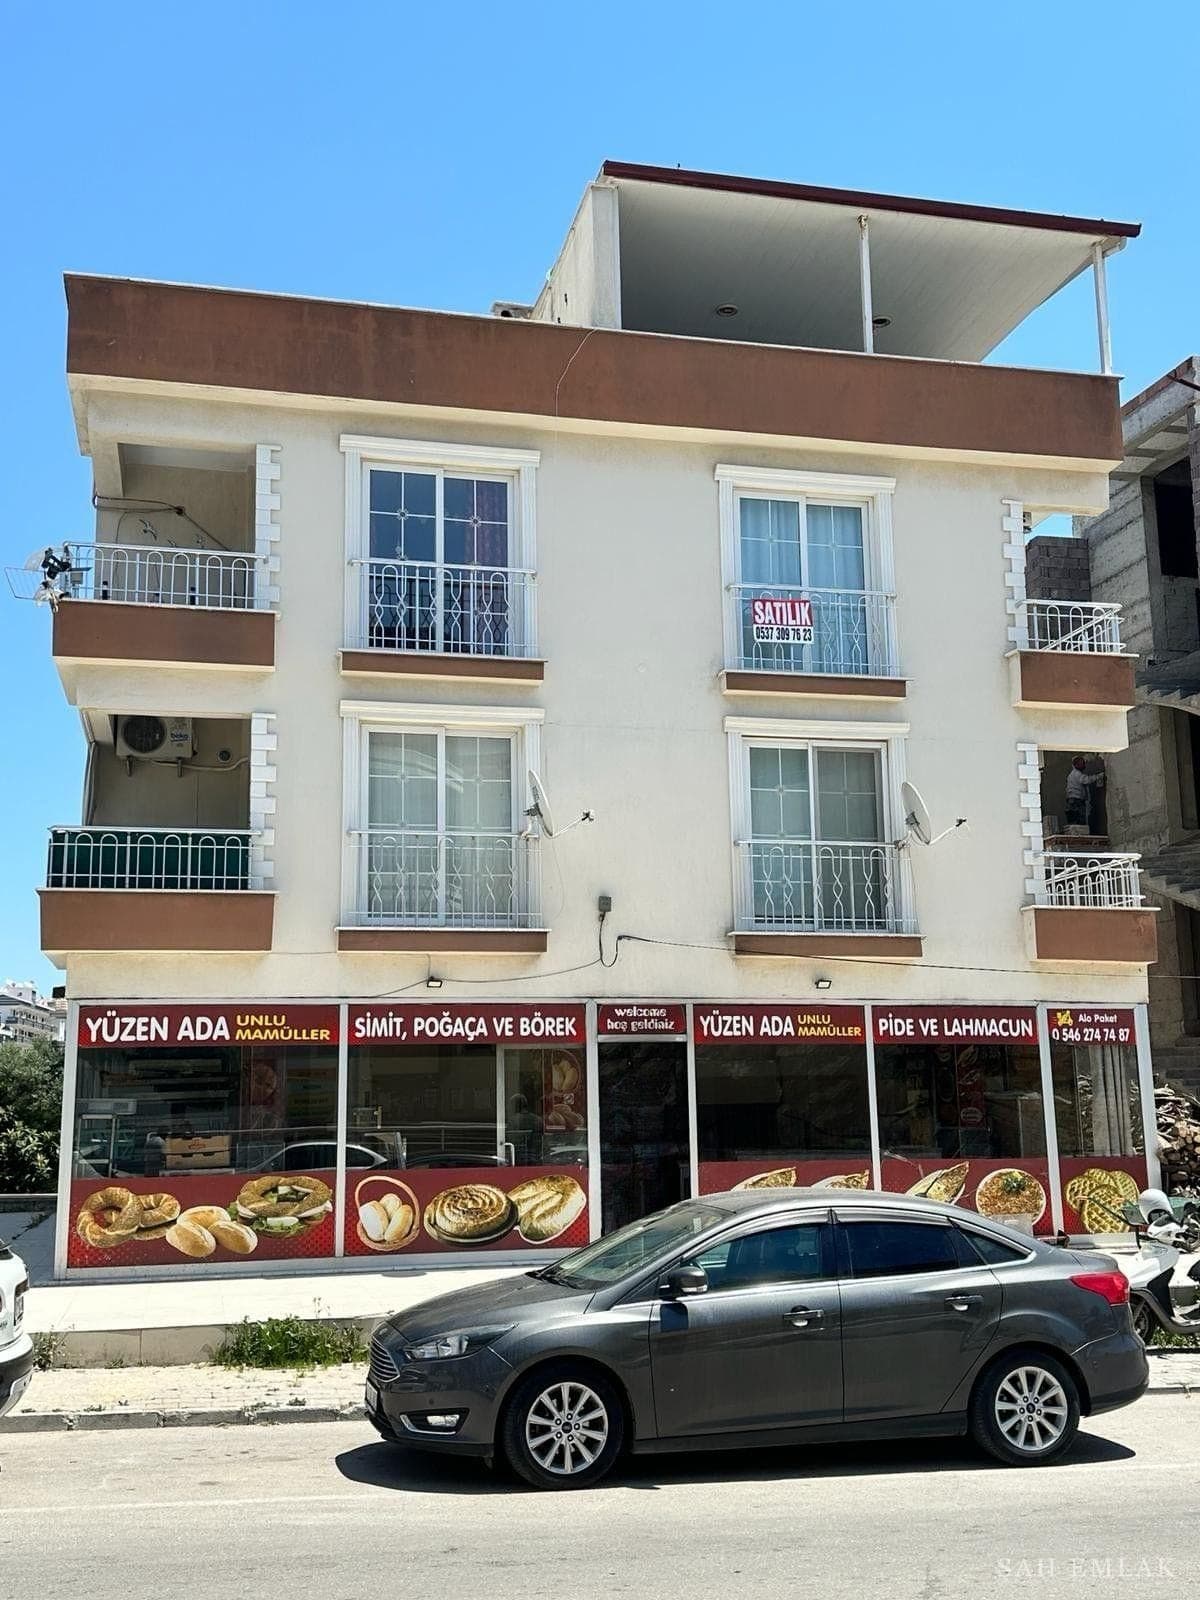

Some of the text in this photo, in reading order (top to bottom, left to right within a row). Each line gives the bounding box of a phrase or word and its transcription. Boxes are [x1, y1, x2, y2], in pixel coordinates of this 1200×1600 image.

[754, 600, 811, 626] SATILIK
[756, 626, 812, 642] 0537 309 76 23
[614, 1006, 667, 1017] welcome
[1078, 1013, 1117, 1024] Alo Paket
[86, 1010, 230, 1043] YÜZEN ADA
[236, 1015, 286, 1026] UNLU
[355, 1011, 577, 1041] SİMİT, POĞAÇA VE BÖREK
[607, 1018, 675, 1032] hoş geldiniz
[700, 1010, 795, 1037] YÜZEN ADA
[798, 1015, 831, 1025] UNLU
[878, 1012, 1033, 1037] PİDE VE LAHMACUN
[235, 1026, 330, 1041] MAMÜLLER
[797, 1025, 862, 1037] MAMÜLLER
[1052, 1028, 1130, 1042] 0 546 274 74 87
